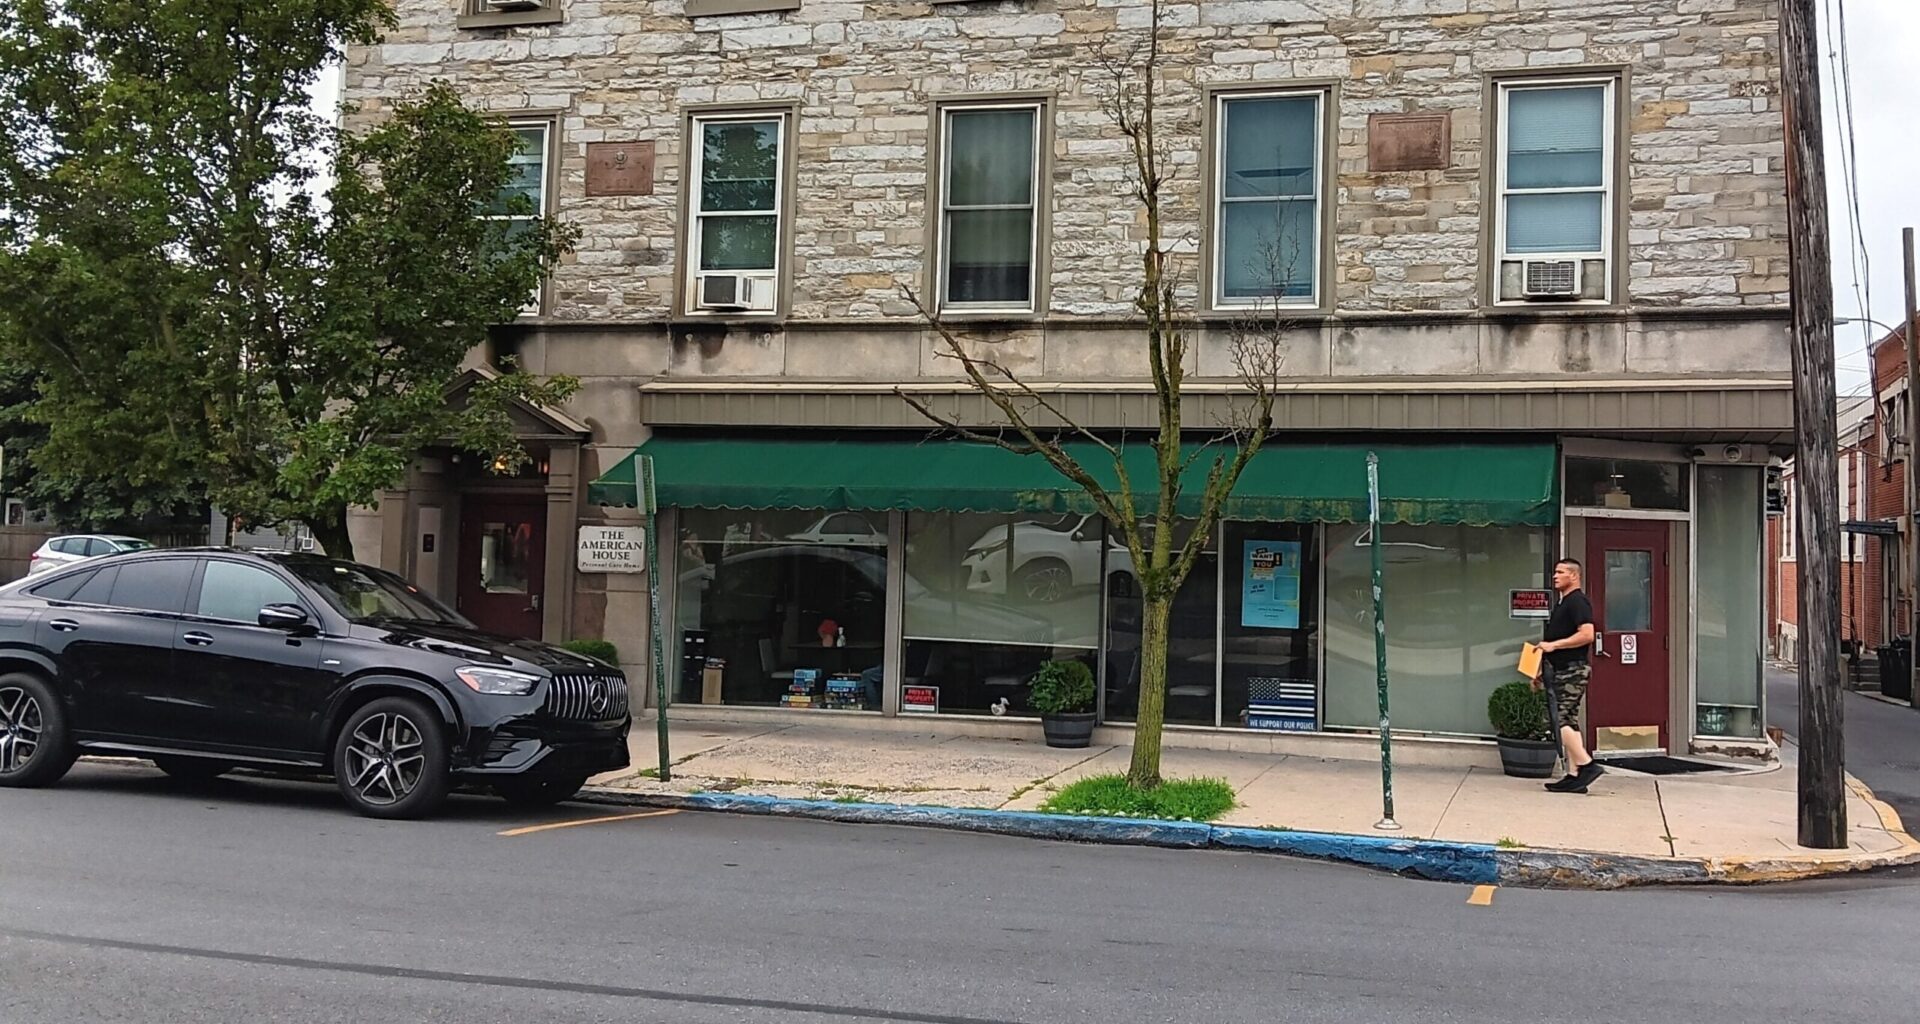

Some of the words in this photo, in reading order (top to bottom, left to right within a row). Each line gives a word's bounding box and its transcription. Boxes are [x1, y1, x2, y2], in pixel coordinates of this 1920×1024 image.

[600, 531, 624, 540] THE
[581, 541, 642, 550] AMERICAN
[592, 551, 630, 560] HOUSE
[1249, 719, 1258, 727] WE
[1259, 719, 1283, 728] SUPPORT
[1283, 721, 1295, 729] OUR
[1296, 722, 1314, 730] POLICE
